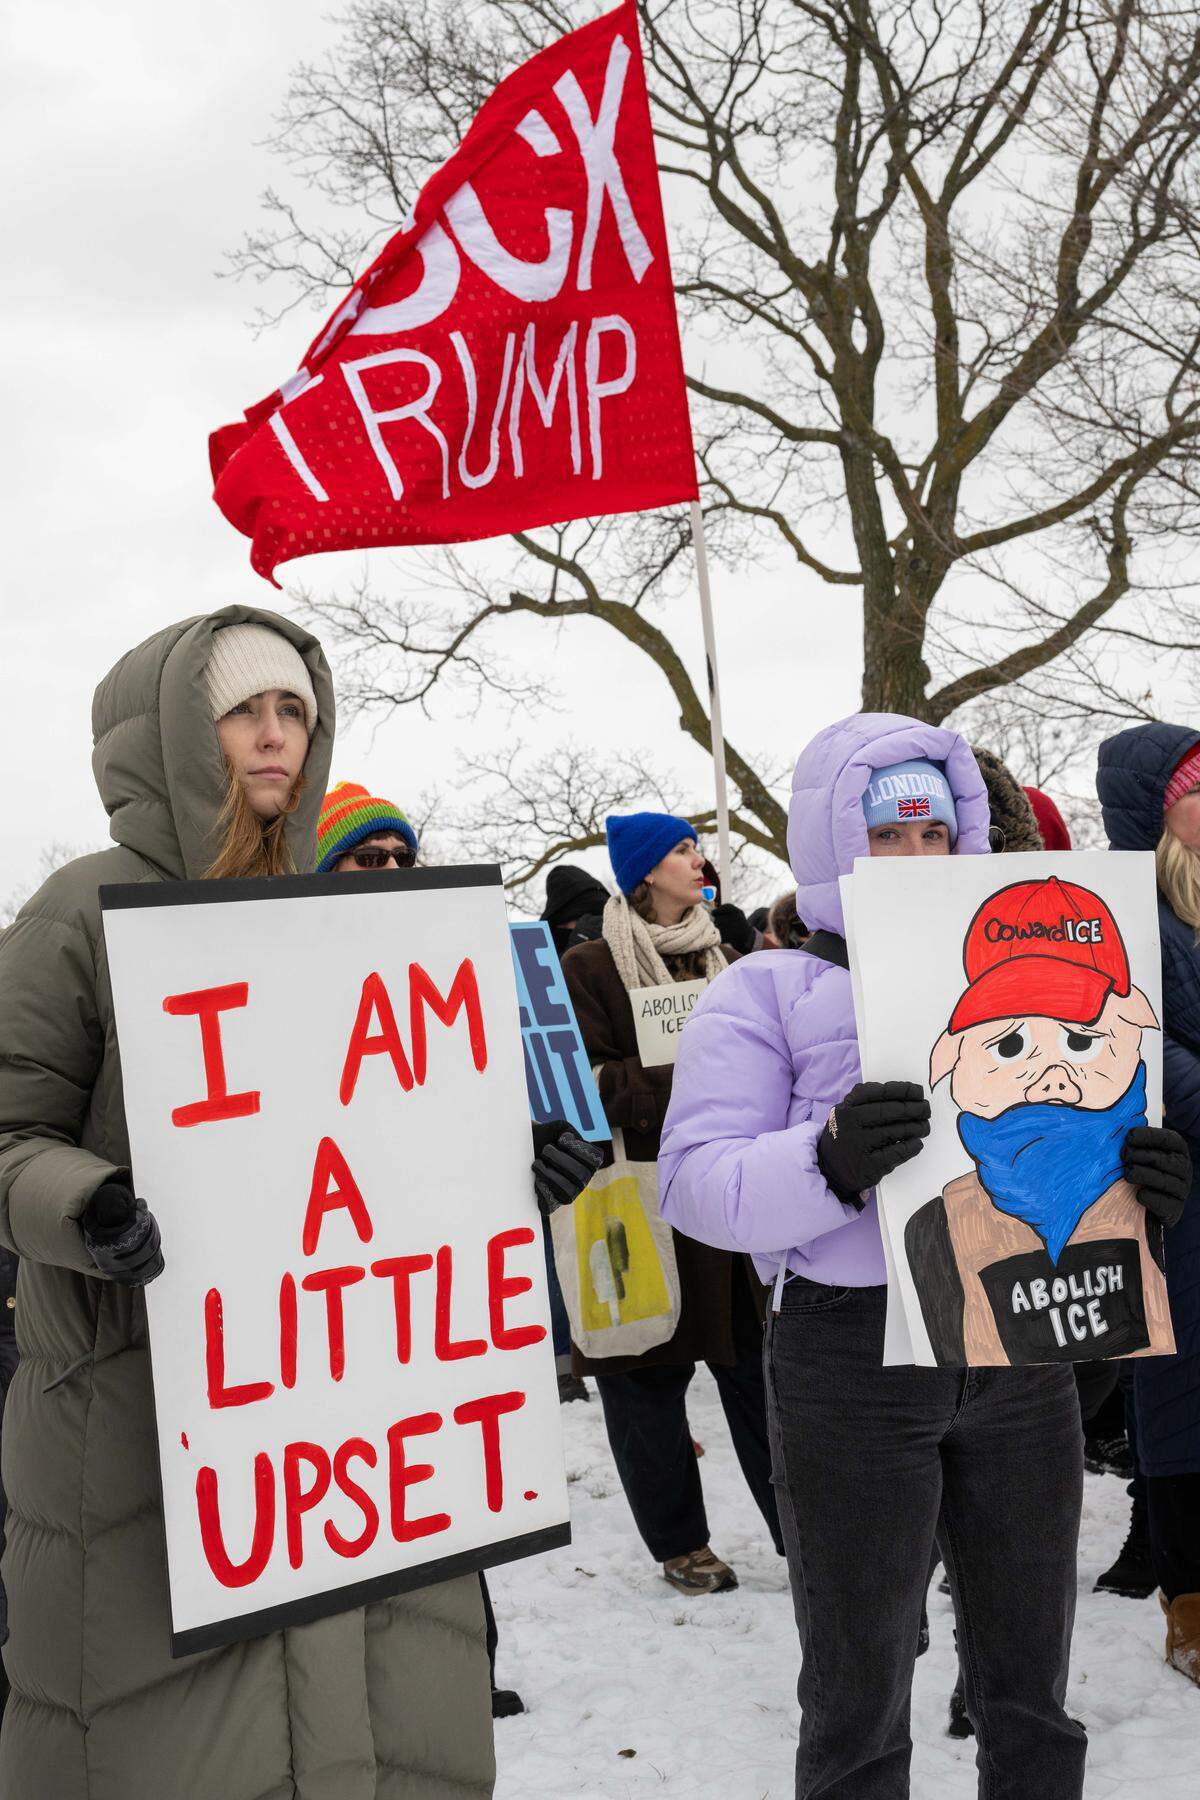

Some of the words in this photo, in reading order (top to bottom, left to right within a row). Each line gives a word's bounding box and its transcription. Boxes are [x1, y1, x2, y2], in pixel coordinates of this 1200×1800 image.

[269, 314, 637, 502] TRUMP
[868, 773, 946, 808] LONDON
[984, 914, 1104, 944] CowardICE
[641, 993, 699, 1018] ABOLIS
[661, 1016, 686, 1034] ICE
[163, 982, 261, 1127] I
[340, 958, 487, 1106] AM
[302, 1136, 373, 1256] A
[1011, 1265, 1124, 1314] ABOLISH
[204, 1227, 547, 1410] LITTLE
[1049, 1298, 1109, 1347] ICE
[196, 1391, 538, 1588] UPSET.
